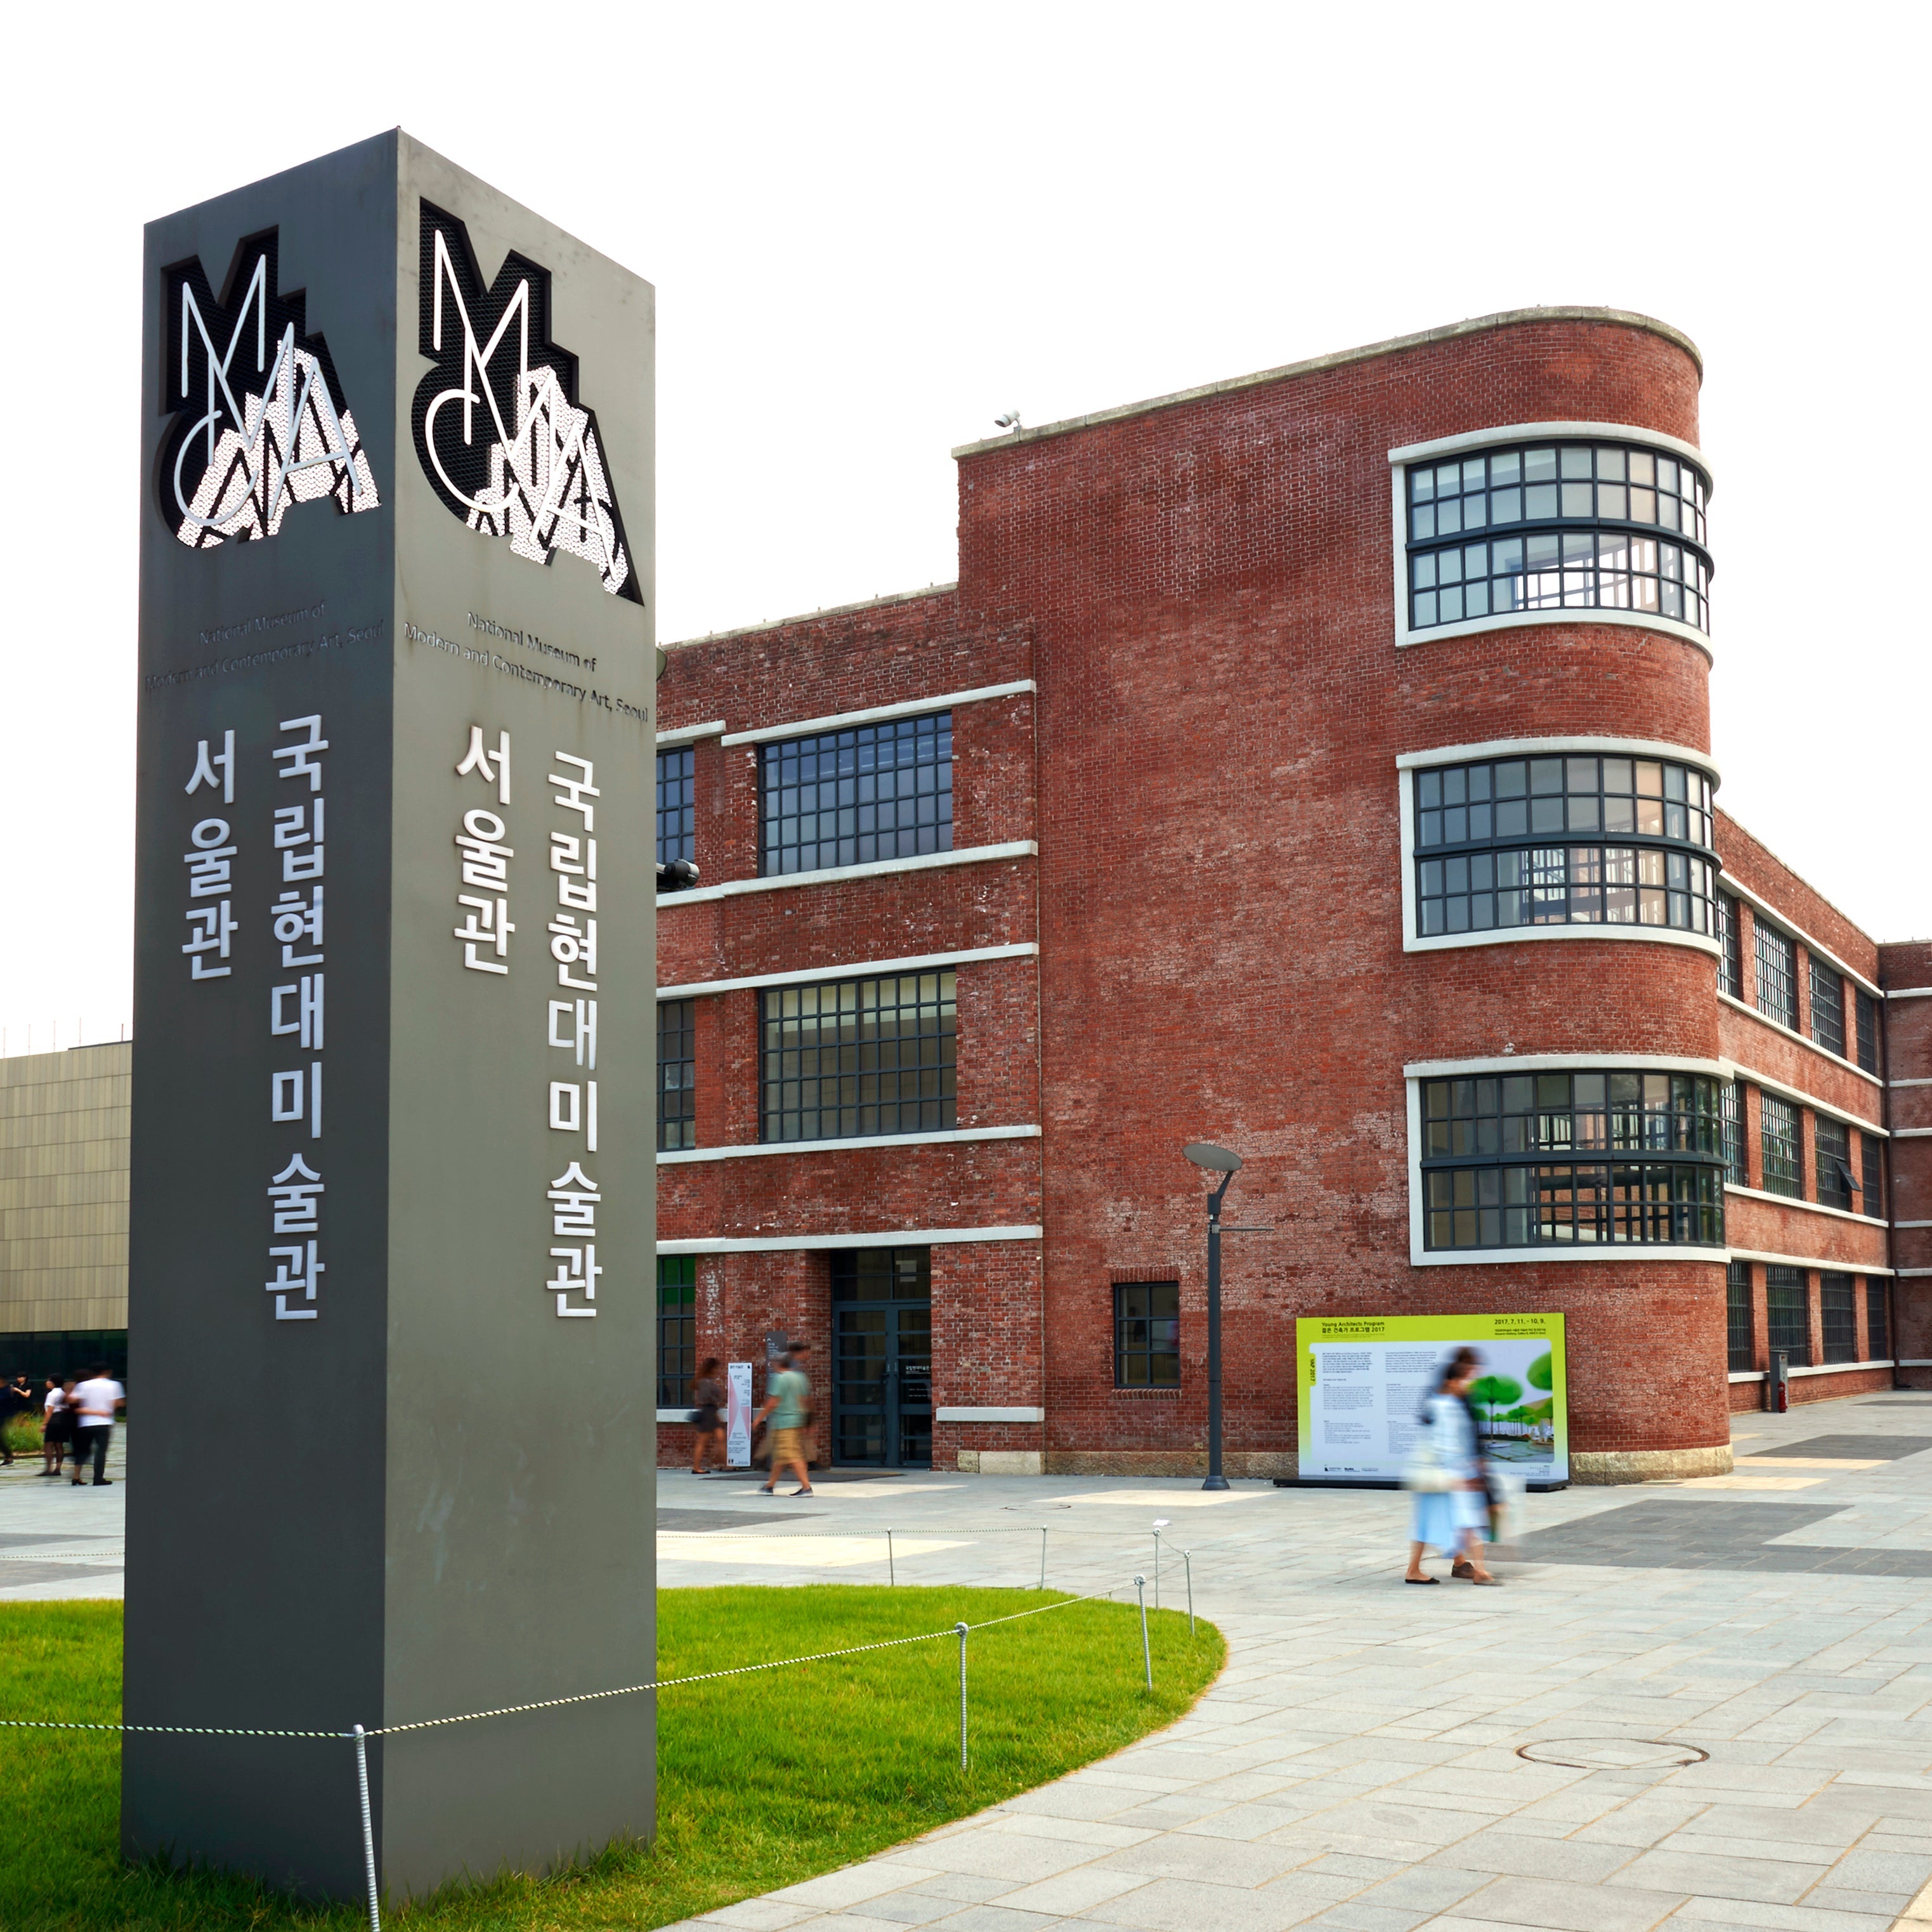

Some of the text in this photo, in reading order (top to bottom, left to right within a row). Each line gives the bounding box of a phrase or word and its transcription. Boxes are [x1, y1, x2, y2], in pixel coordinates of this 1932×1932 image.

[145, 619, 384, 691] Modern and Contemporary Art, Seoul
[199, 599, 326, 646] National Museum of
[404, 622, 648, 722] Modern and Contemporary Art, Seoul
[467, 611, 597, 672] National Museum of
[182, 729, 238, 980] 서울관
[454, 725, 515, 974] 서울관
[265, 714, 329, 1320] 국립현대미술관
[546, 751, 603, 1317] 국립현대미술관
